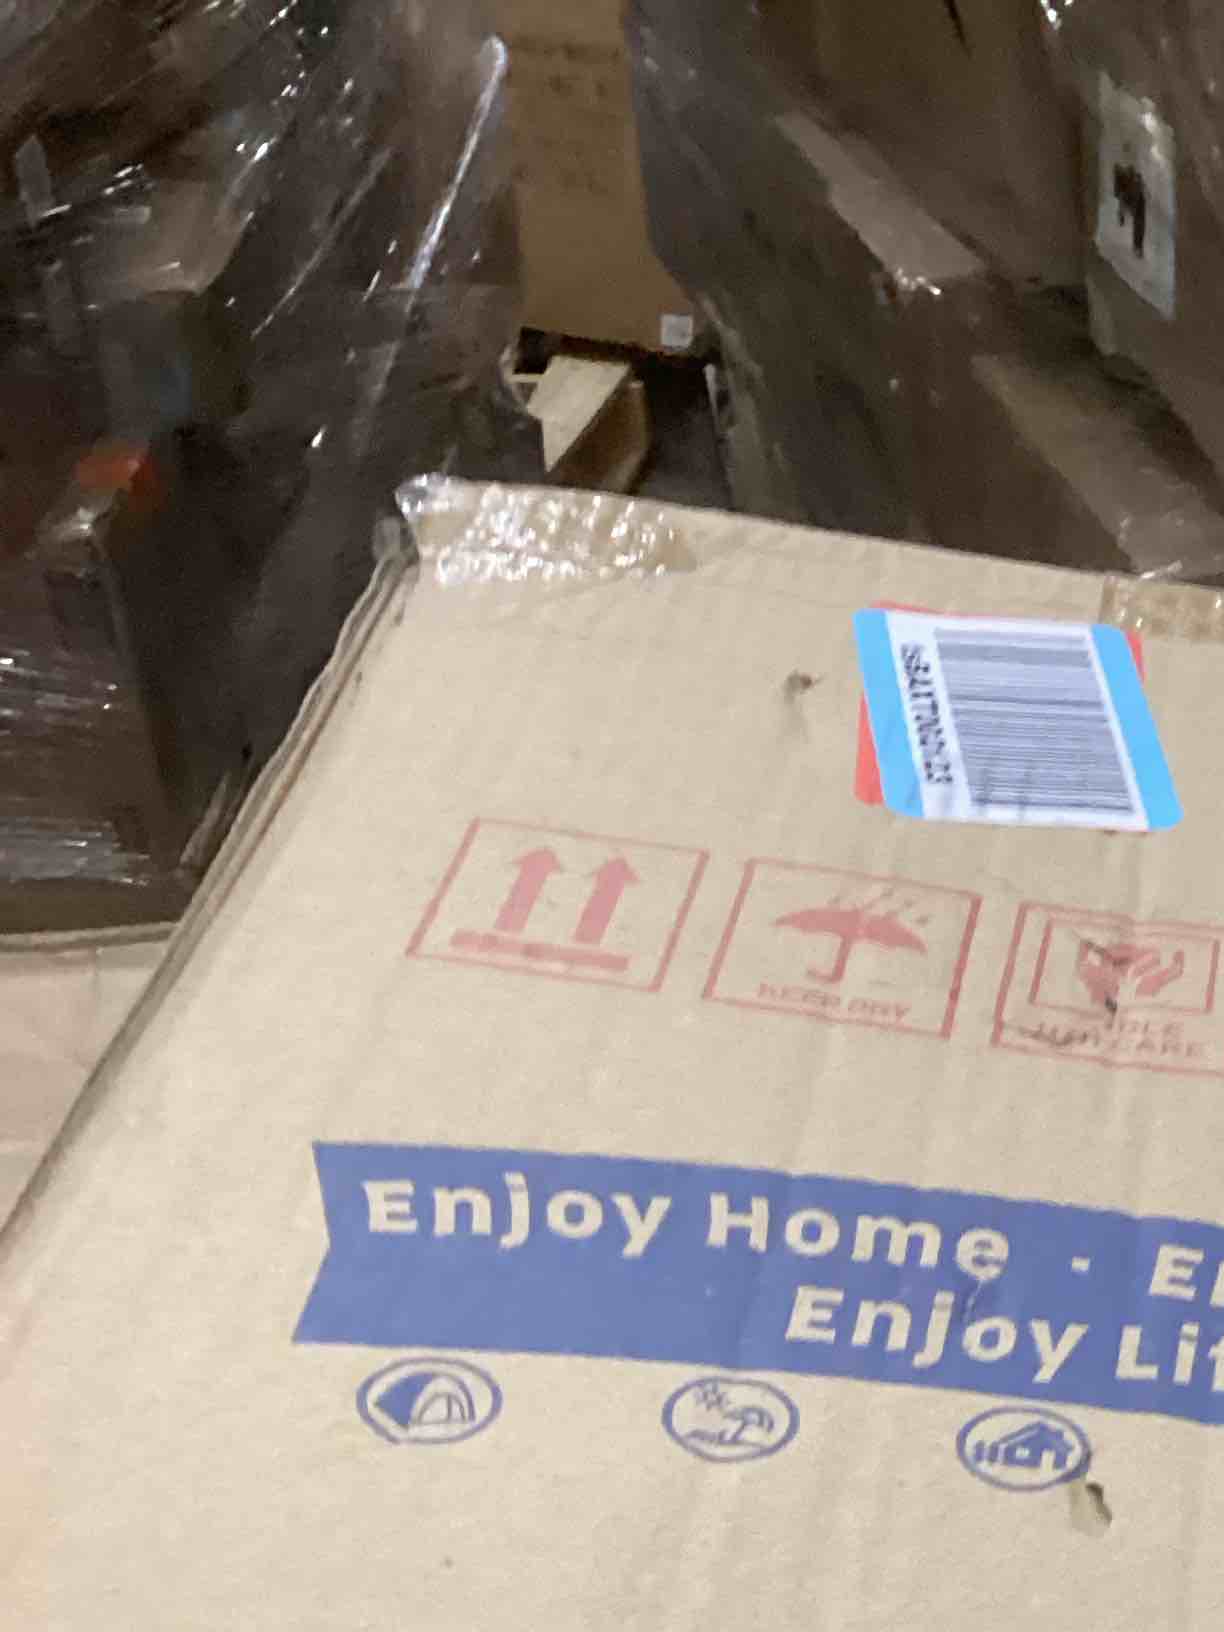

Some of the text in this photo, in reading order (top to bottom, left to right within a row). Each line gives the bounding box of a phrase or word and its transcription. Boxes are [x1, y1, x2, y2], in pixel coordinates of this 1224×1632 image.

[362, 1172, 673, 1258] Enjoy
[705, 1191, 1010, 1281] Home
[784, 1284, 1088, 1384] Enjoy
